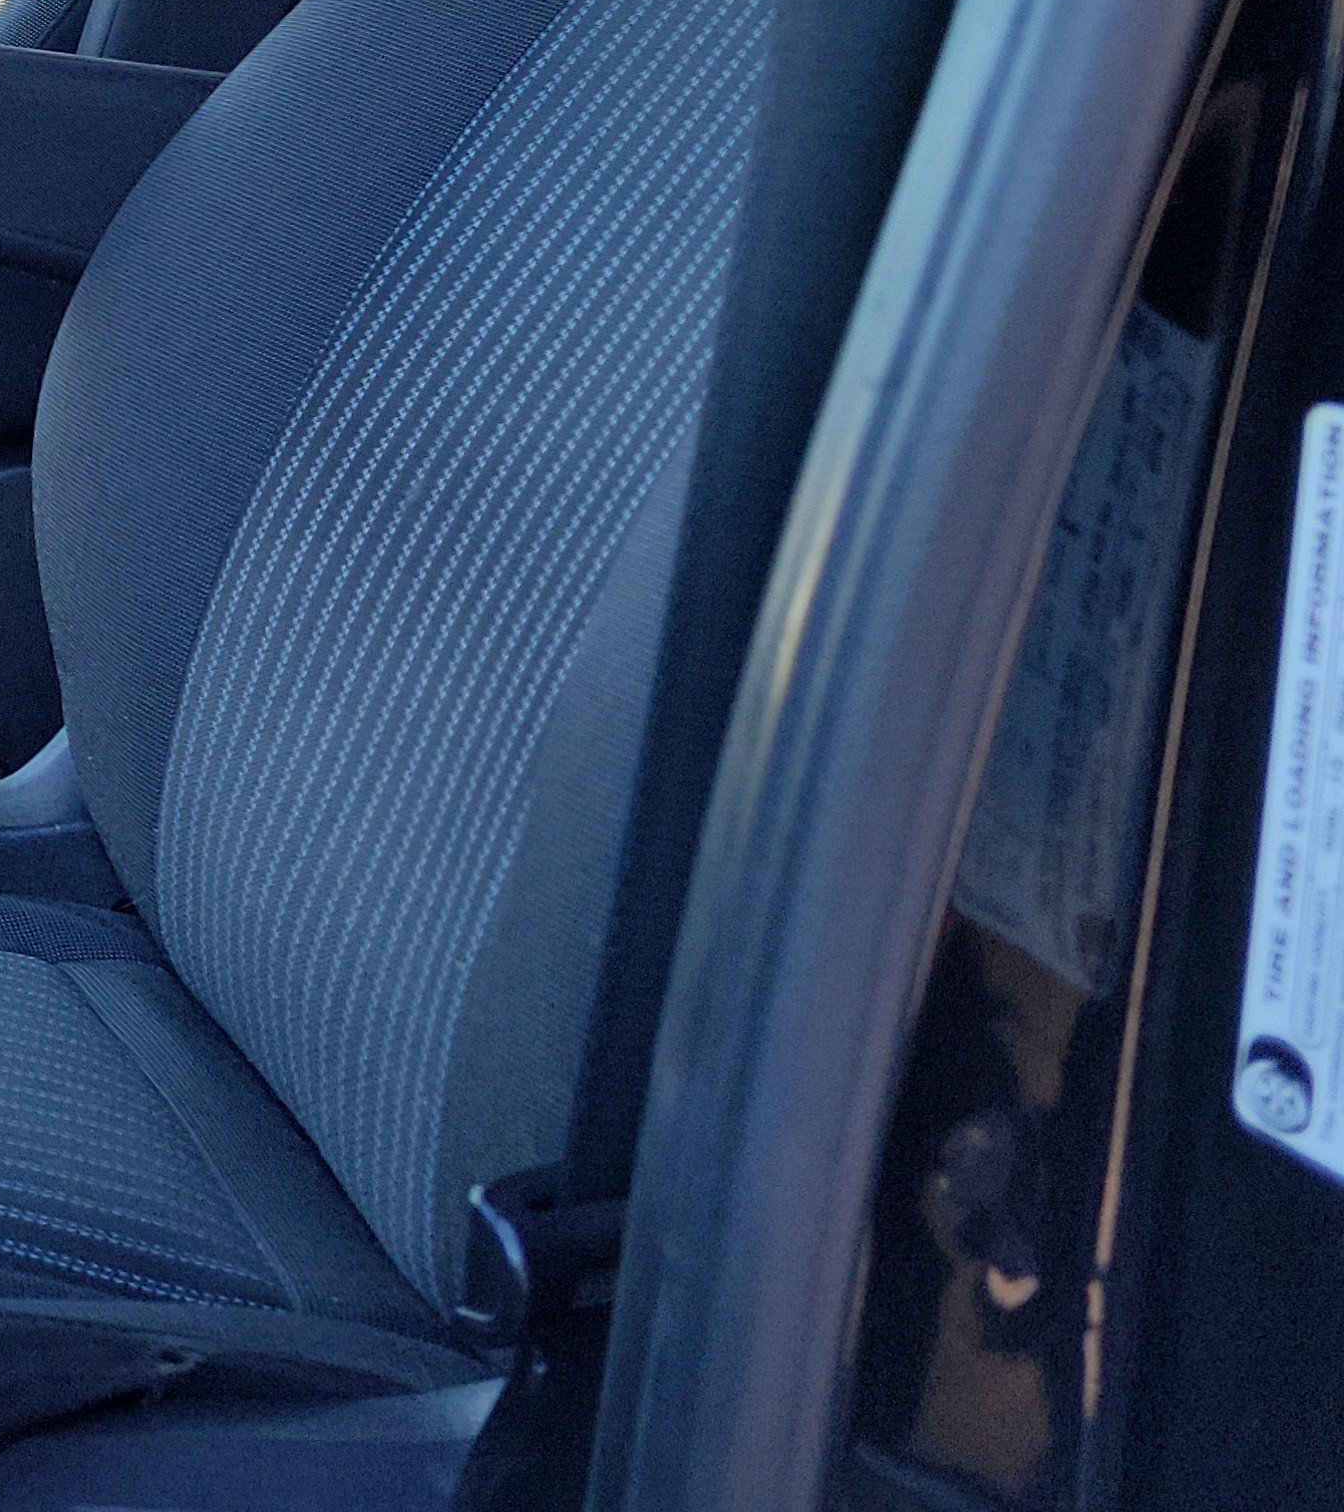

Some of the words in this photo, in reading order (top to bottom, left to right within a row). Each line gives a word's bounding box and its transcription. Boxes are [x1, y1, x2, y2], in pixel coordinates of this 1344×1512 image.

[1302, 423, 1341, 666] INFORMATION
[1284, 678, 1316, 834] LOADING
[1273, 843, 1297, 916] AND
[1262, 926, 1289, 1004] TIRE
